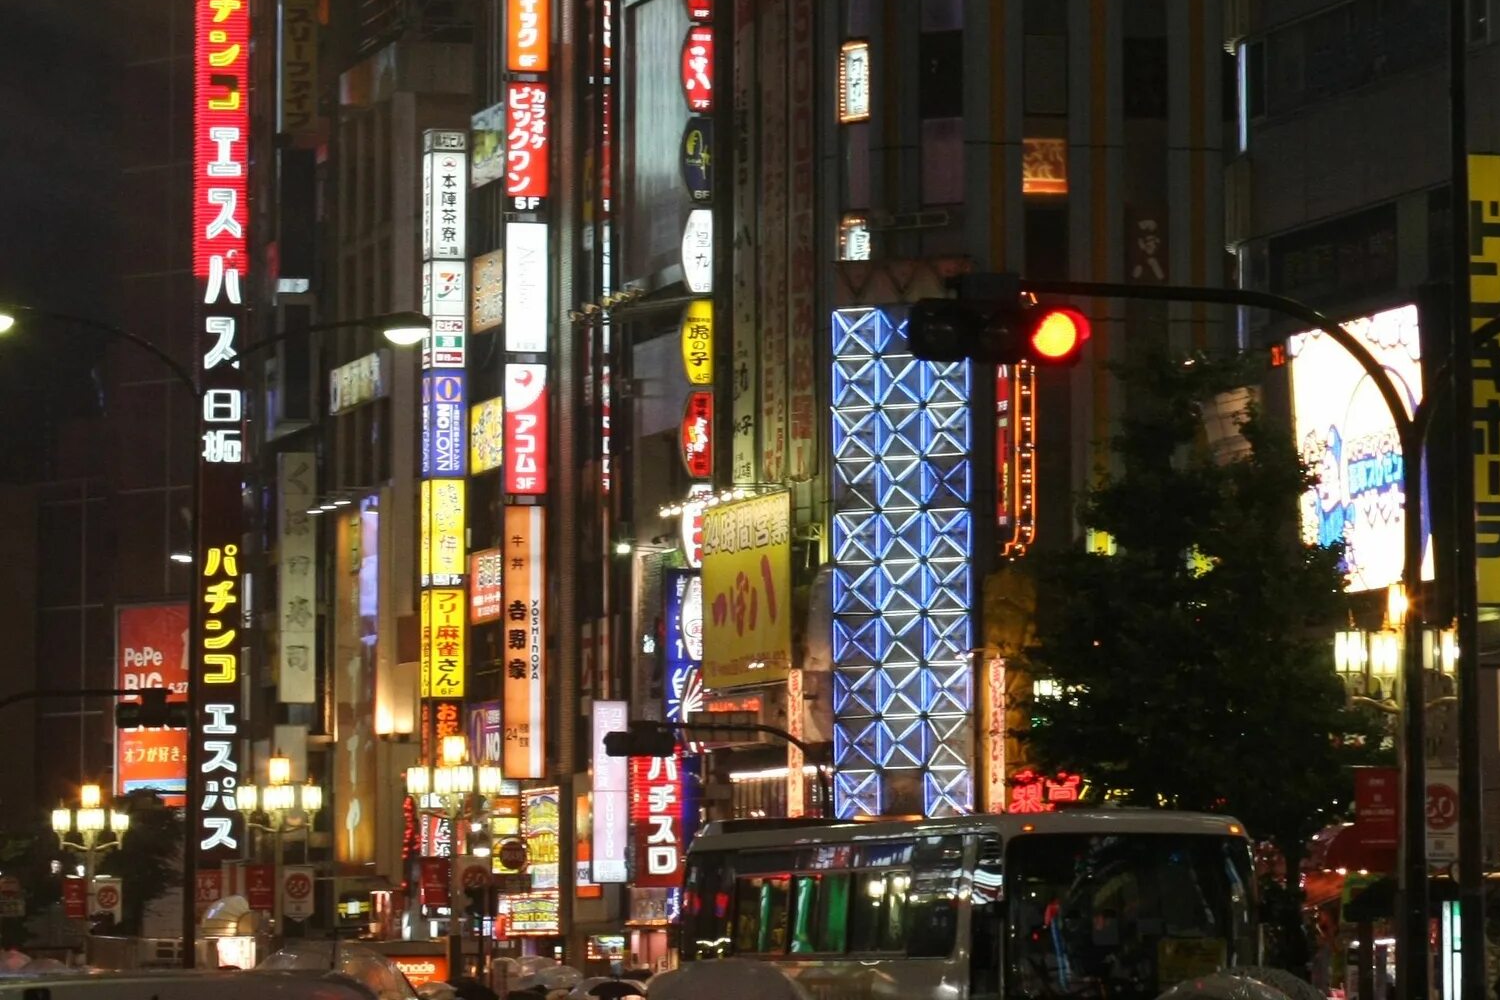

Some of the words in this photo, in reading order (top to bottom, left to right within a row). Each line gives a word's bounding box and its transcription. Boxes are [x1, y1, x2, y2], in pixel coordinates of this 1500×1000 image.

[508, 88, 531, 193] ビックワン
[530, 89, 547, 149] カラオケ
[441, 174, 456, 242] 本陣茶寮
[515, 197, 540, 210] 5F
[204, 127, 242, 370] エスパス
[687, 324, 711, 367] 虎の子
[202, 389, 242, 463] 日拓
[515, 415, 536, 473] アコム
[516, 478, 536, 489] 3F
[512, 536, 524, 570] 牛丼
[703, 500, 789, 556] 24時間営業
[203, 544, 239, 684] パチンコ
[437, 592, 461, 687] フリー麻雀さん
[508, 600, 527, 679] 吉野家
[124, 647, 163, 668] PePe
[200, 704, 238, 850] エスパス
[648, 753, 679, 875] パチスロ
